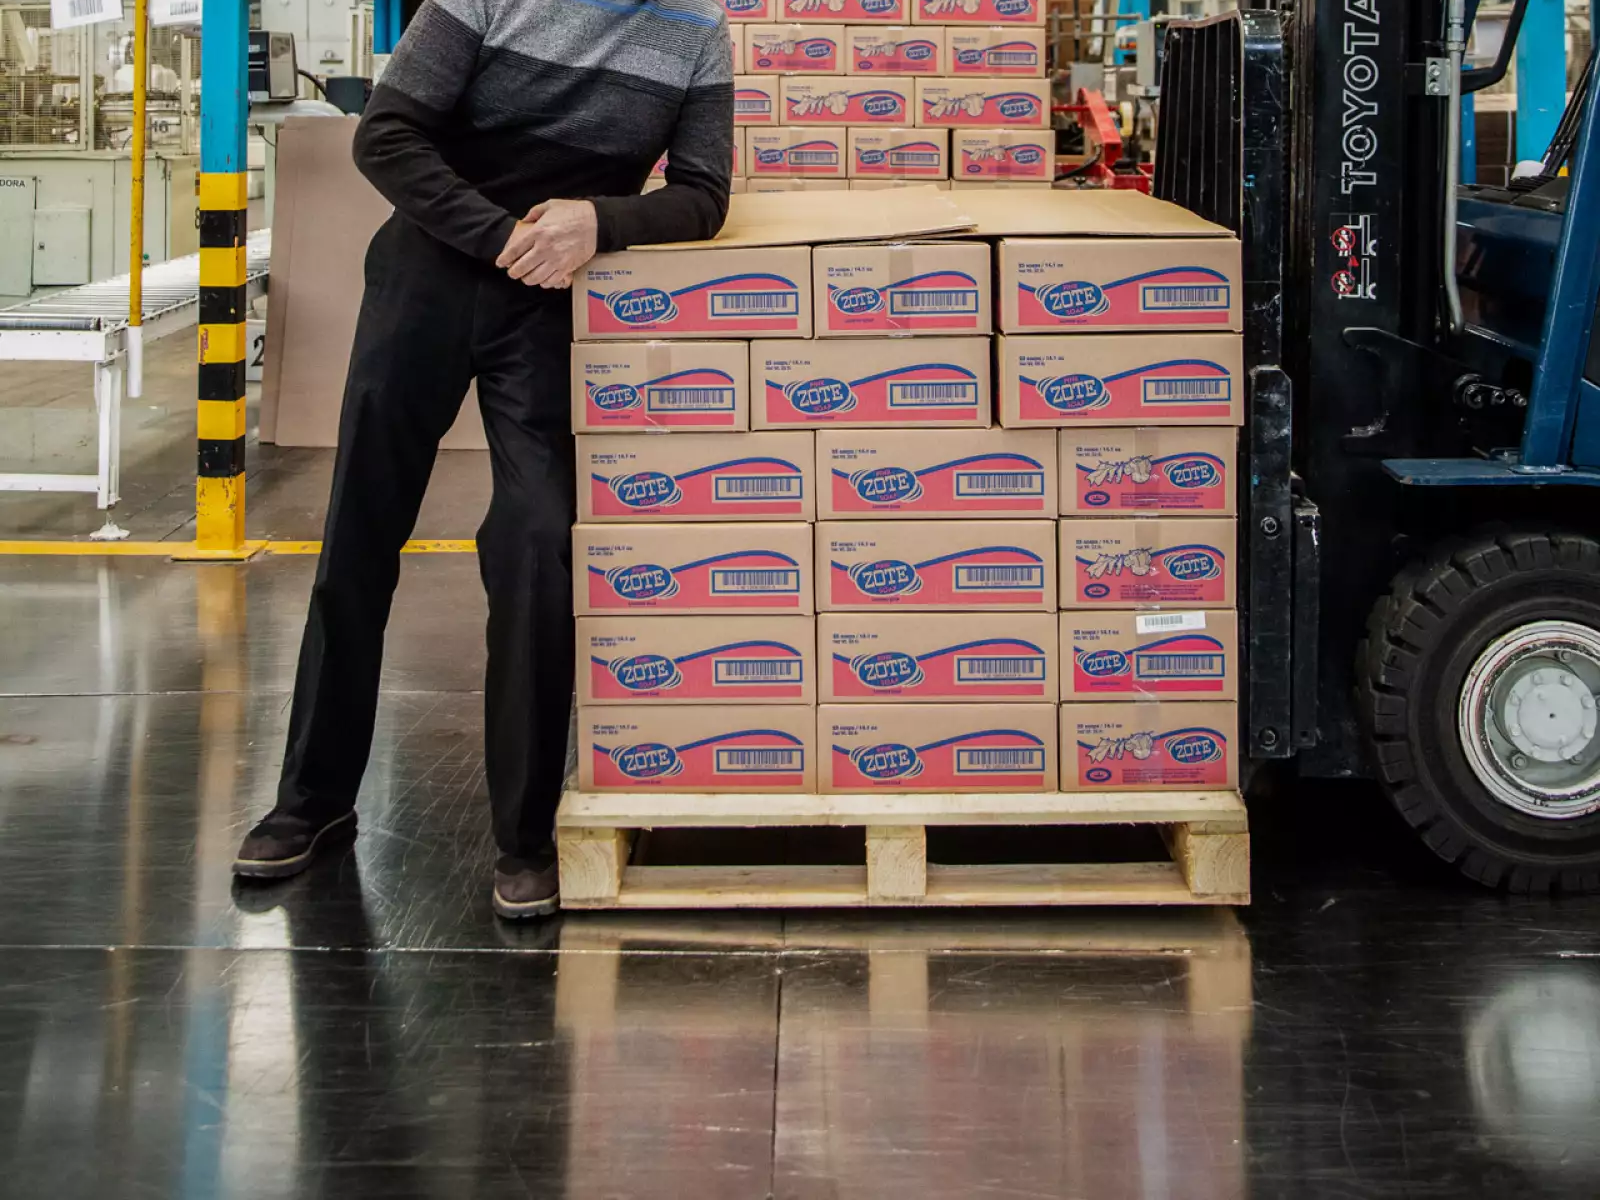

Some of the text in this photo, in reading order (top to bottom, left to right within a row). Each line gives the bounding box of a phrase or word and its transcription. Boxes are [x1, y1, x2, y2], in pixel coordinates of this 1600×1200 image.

[619, 294, 665, 317] ZOTE
[841, 292, 875, 309] ZOTE
[1050, 286, 1096, 310] ZOTE
[598, 389, 633, 406] ZOTE
[797, 384, 843, 407] ZOTE
[1050, 380, 1097, 403] ZOTE
[863, 473, 910, 497] ZOTE
[1174, 466, 1210, 483] ZOTE
[622, 477, 670, 500] ZOTE
[1173, 558, 1210, 575] ZOTE
[619, 570, 666, 593] ZOTE
[862, 567, 908, 589] ZOTE
[622, 660, 669, 683] ZOTE
[864, 658, 911, 681] ZOTE
[1087, 654, 1121, 671] ZOTE
[623, 749, 670, 771] ZOTE
[864, 749, 910, 771] ZOTE
[1175, 740, 1211, 758] ZOTE
